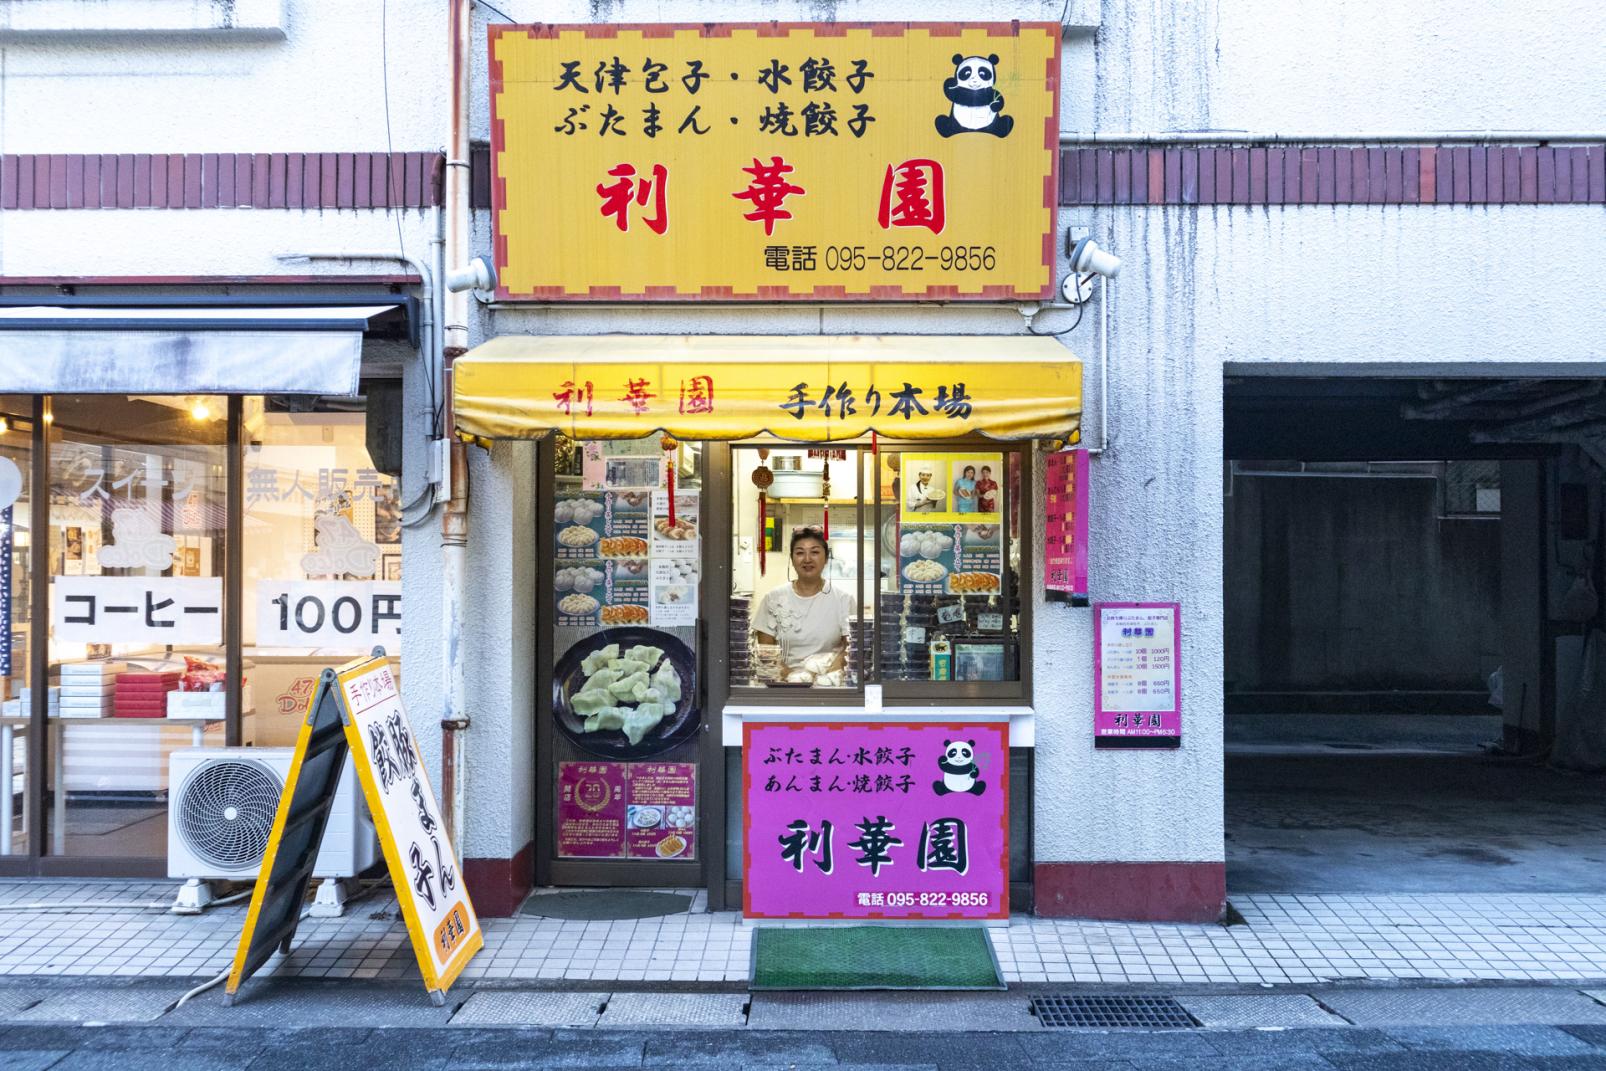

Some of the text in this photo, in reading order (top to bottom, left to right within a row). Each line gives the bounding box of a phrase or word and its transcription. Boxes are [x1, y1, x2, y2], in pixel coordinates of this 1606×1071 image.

[596, 156, 948, 237] 利華園
[763, 245, 997, 272] 電話 095-822-9856
[552, 375, 714, 418] 利華園
[779, 382, 973, 422] 手作り本場
[246, 467, 401, 502] 無人販売
[64, 590, 219, 628] コーヒー
[272, 592, 402, 635] 100円
[278, 695, 310, 713] Dol
[1114, 713, 1161, 728] 利華園
[778, 815, 970, 878] 利華園
[857, 892, 989, 907] 電話 095-822-9856
